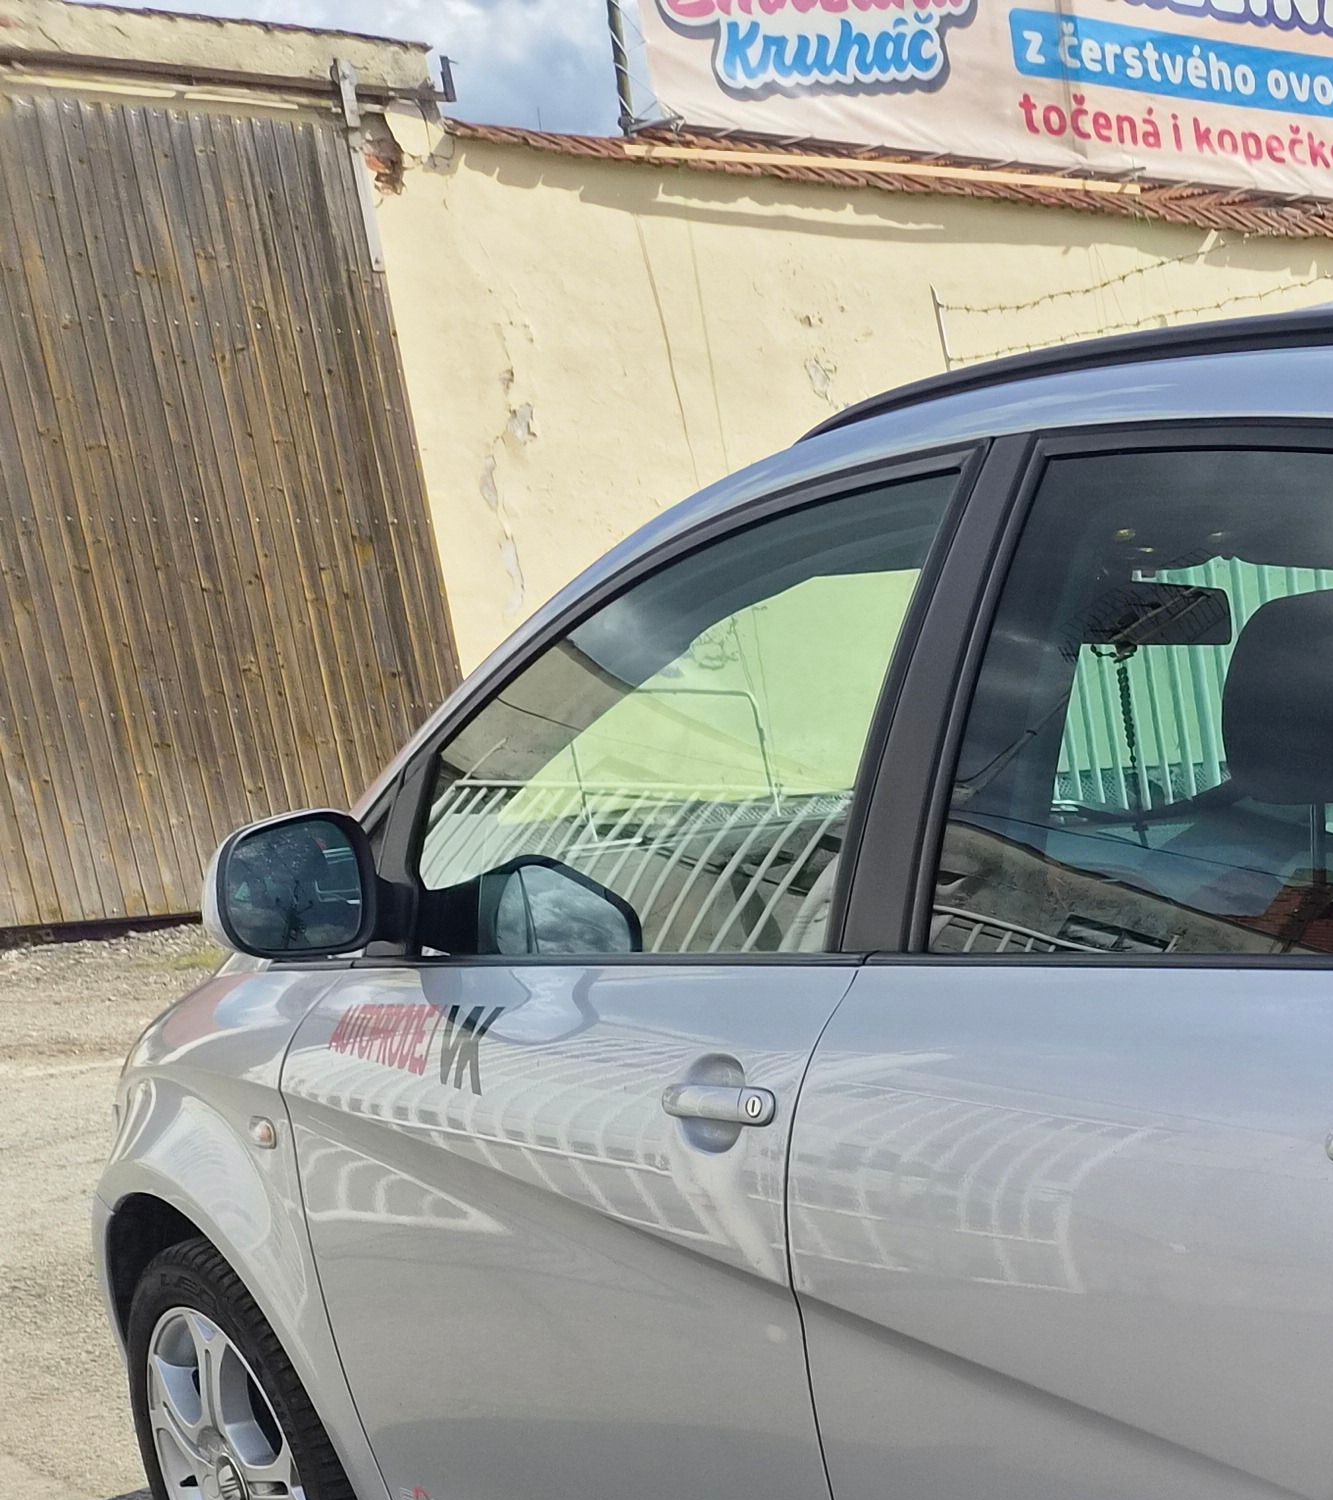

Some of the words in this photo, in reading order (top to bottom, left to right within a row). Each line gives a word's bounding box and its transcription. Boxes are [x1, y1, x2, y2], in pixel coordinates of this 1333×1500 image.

[723, 12, 938, 80] Kruháč
[1022, 30, 1045, 65] z
[1060, 22, 1256, 97] čerstvého
[1019, 93, 1163, 151] točená
[1171, 113, 1182, 153] i
[440, 1005, 505, 1096] VK
